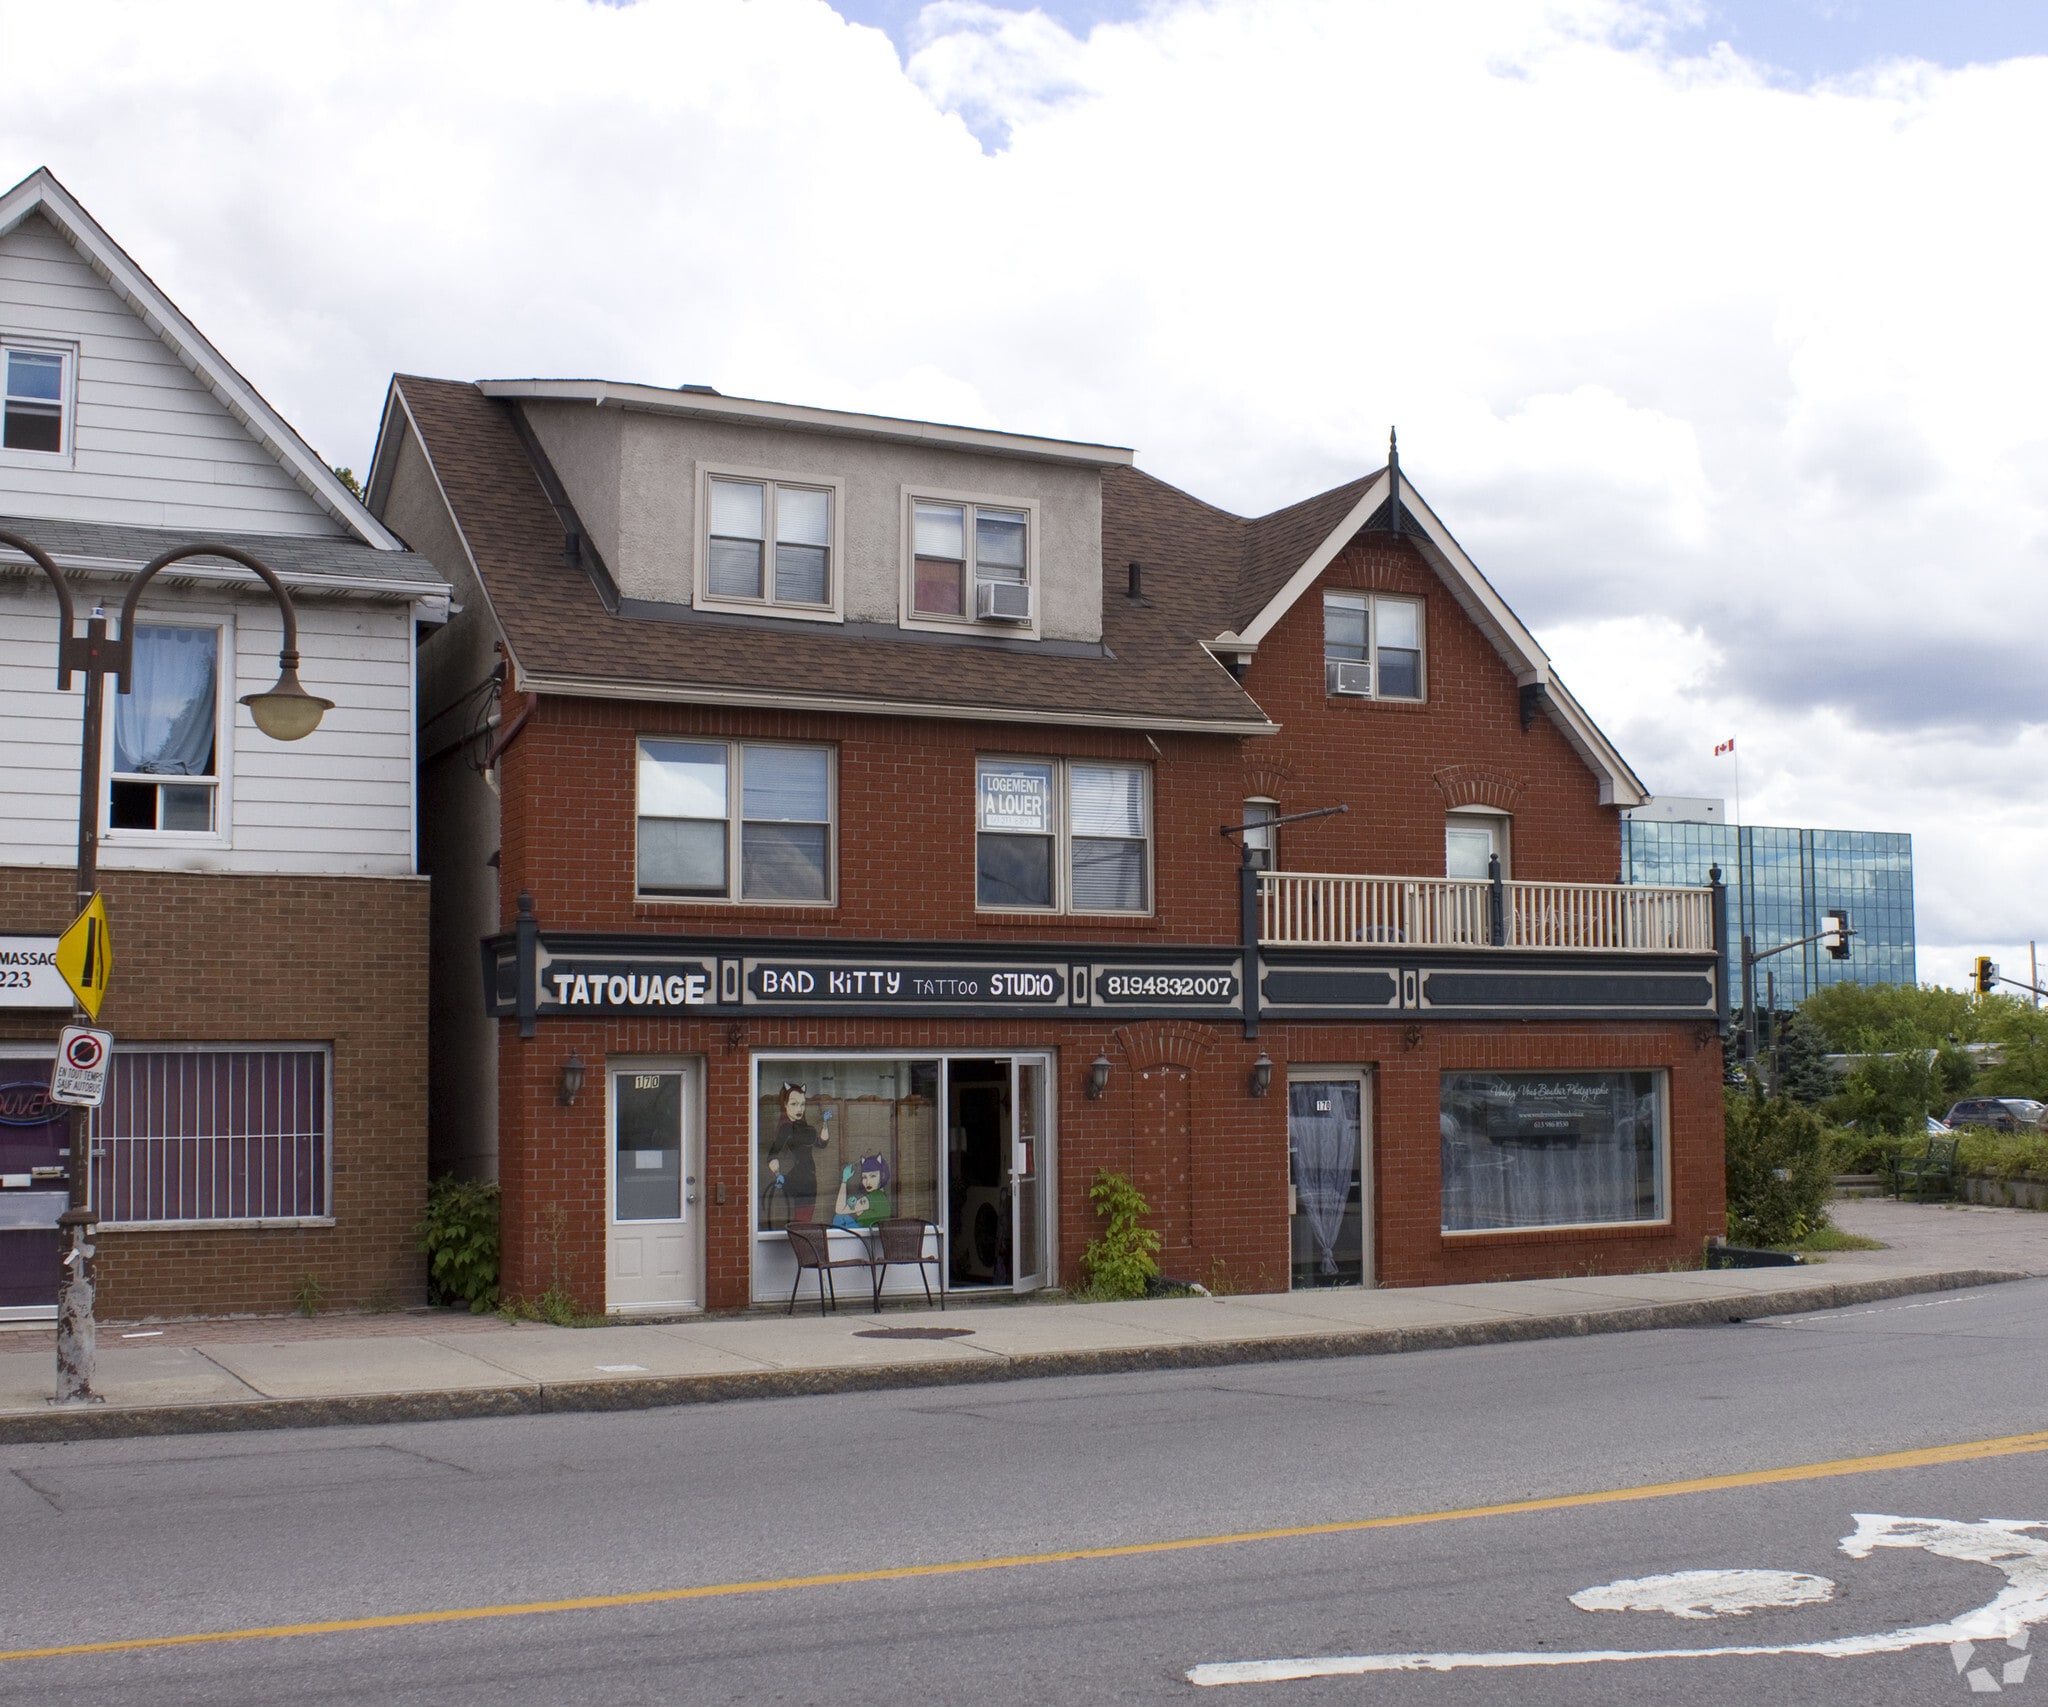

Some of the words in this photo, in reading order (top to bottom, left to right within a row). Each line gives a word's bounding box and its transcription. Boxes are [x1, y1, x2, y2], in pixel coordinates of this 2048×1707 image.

[987, 777, 1039, 793] LOGEMENT
[985, 791, 996, 814] A
[998, 793, 1042, 816] LOUER
[0, 951, 57, 966] MASSAG
[553, 974, 706, 1005] TATOUAGE
[763, 970, 815, 993] BAD
[58, 1067, 67, 1077] EN
[67, 1068, 82, 1080] TOUT
[84, 1070, 104, 1083] TEMPS
[636, 1076, 660, 1089] 170
[57, 1078, 73, 1090] SAUF
[73, 1080, 102, 1094] AUTOBUS
